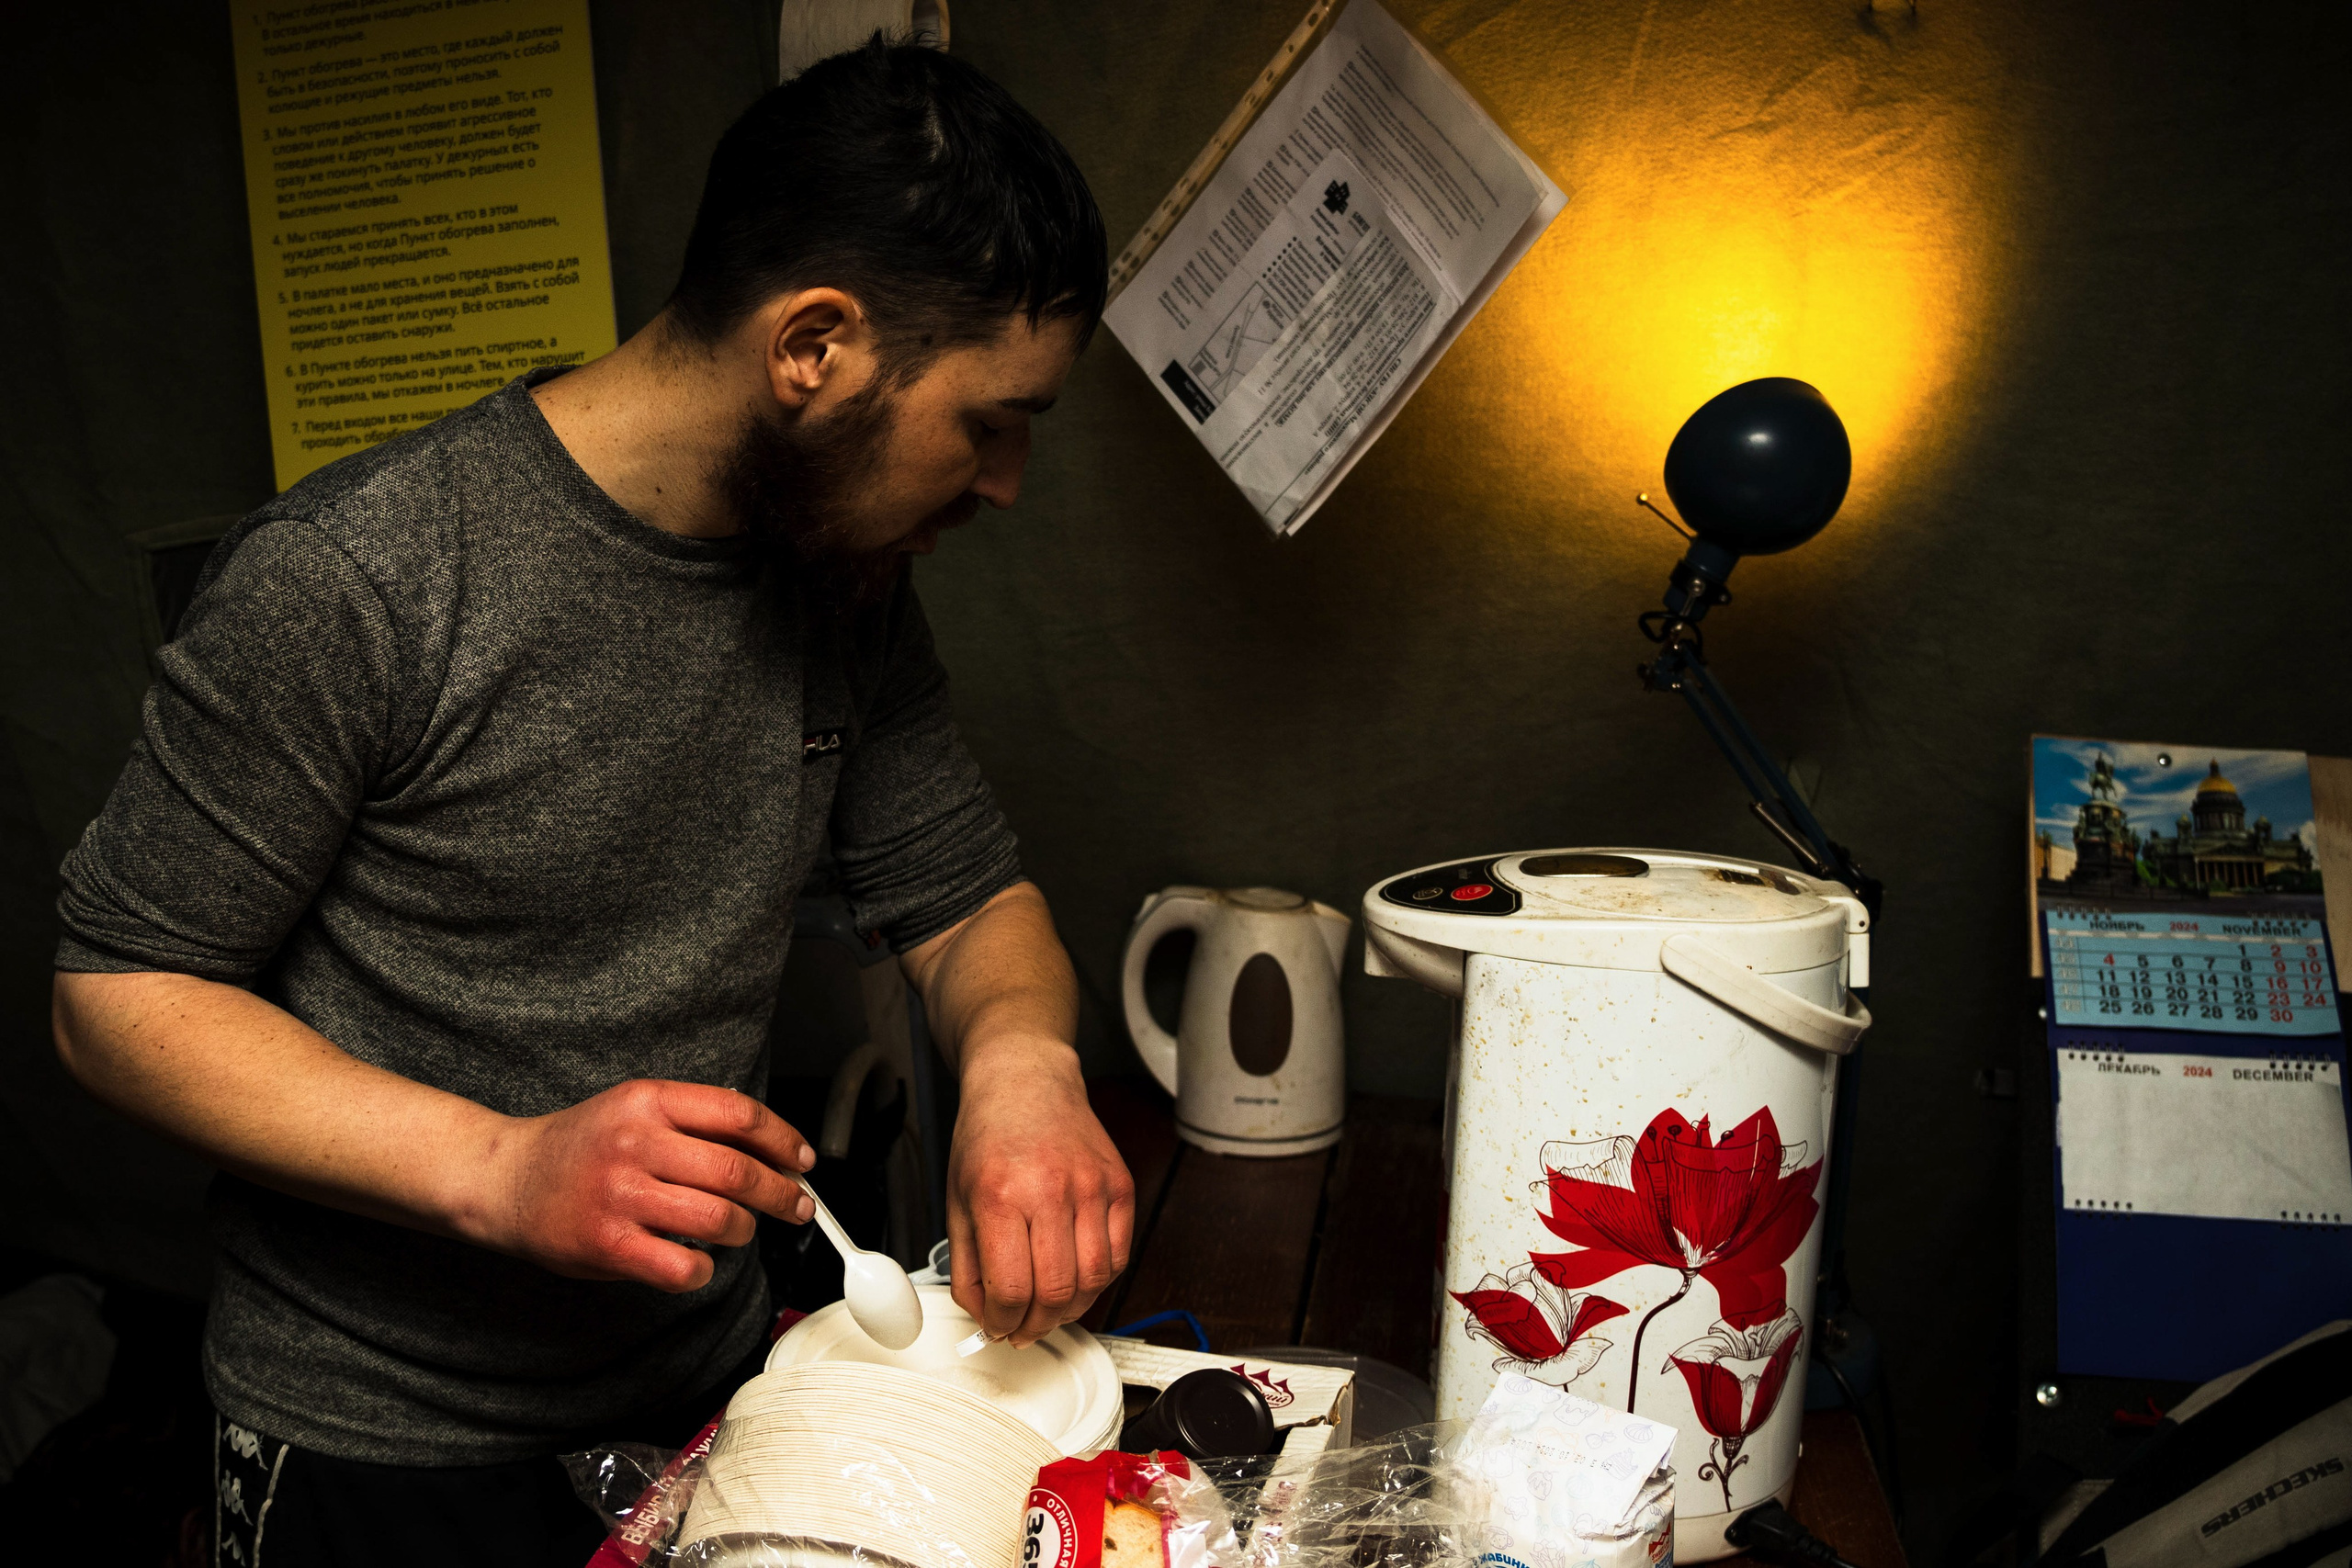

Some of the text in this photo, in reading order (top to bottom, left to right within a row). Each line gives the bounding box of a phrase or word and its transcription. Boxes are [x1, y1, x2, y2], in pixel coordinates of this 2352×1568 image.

[271, 106, 536, 154] словом или действием проявит агрессивное
[276, 125, 296, 137] Мы
[299, 118, 341, 135] против
[343, 111, 391, 127] насилия
[394, 109, 401, 119] в
[404, 103, 445, 118] любом
[447, 99, 468, 111] его
[531, 86, 552, 98] кто
[273, 152, 335, 170] поведение
[338, 152, 344, 161] к
[347, 143, 395, 161] другому
[458, 128, 504, 144] должен
[507, 122, 540, 138] будет
[274, 174, 306, 188] сразу
[309, 171, 323, 182] же
[326, 163, 381, 179] покинуть
[435, 152, 443, 164] У
[447, 144, 508, 164] дежурных
[512, 140, 539, 152] есть
[276, 191, 295, 202] все
[377, 174, 412, 188] чтобы
[415, 167, 465, 185] принять
[469, 159, 524, 178] решение
[527, 157, 536, 167] о
[277, 201, 341, 219] выселении
[286, 231, 306, 243] Мы
[309, 224, 368, 241] стараемся
[371, 217, 420, 233] принять
[456, 209, 476, 220] кто
[479, 208, 486, 218] в
[489, 203, 518, 216] этом
[348, 241, 363, 252] но
[366, 236, 397, 249] когда
[400, 231, 435, 246] Пункт
[437, 223, 494, 240] обогрева
[283, 263, 320, 276] запуск
[323, 256, 360, 271] людей
[291, 289, 300, 301] В
[302, 286, 347, 299] палатке
[350, 281, 379, 294] мало
[422, 275, 430, 285] и
[433, 272, 456, 284] оно
[458, 259, 553, 282] предназначено
[556, 256, 579, 269] для
[339, 302, 346, 311] а
[348, 299, 363, 310] не
[365, 297, 387, 310] для
[390, 289, 447, 307] хранения
[495, 279, 530, 292] Взять
[532, 278, 538, 288] с
[542, 271, 580, 287] собой
[288, 321, 327, 333] можно
[330, 317, 358, 329] один
[362, 312, 393, 325] пакет
[396, 310, 419, 321] или
[461, 299, 482, 313] Всё
[485, 293, 549, 310] остальное
[290, 335, 343, 352] придется
[345, 329, 398, 344] оставить
[299, 364, 308, 375] В
[310, 360, 350, 376] Пункте
[353, 354, 407, 368] обогрева
[410, 349, 451, 362] нельзя
[454, 345, 483, 357] пить
[549, 337, 557, 346] а
[294, 378, 334, 393] курить
[337, 374, 376, 387] можно
[379, 369, 418, 382] только
[421, 367, 435, 378] на
[506, 356, 527, 367] кто
[296, 397, 315, 407] эти
[371, 389, 390, 399] мы
[392, 382, 443, 397] откажем
[445, 381, 453, 391] в
[803, 733, 842, 757] FILA
[2169, 921, 2199, 931] 2024
[2222, 924, 2301, 936] NOVEMBER
[2104, 953, 2322, 975] 4 5 6 7 8 9 10
[2239, 944, 2317, 958] 1 2 3
[2098, 969, 2323, 991] 11 12 13 14 15 16 17
[2099, 984, 2326, 1007] 18 19 20 21 22 23 24
[2099, 1000, 2293, 1023] 25 26 27 28 29 30
[2183, 1066, 2213, 1077] 2024
[2233, 1068, 2313, 1082] DECEMBER
[2200, 1458, 2346, 1539] SKECHERS
[1023, 1513, 1045, 1568] 36
[1046, 1498, 1073, 1568] ОТЛИЧНАЯ
